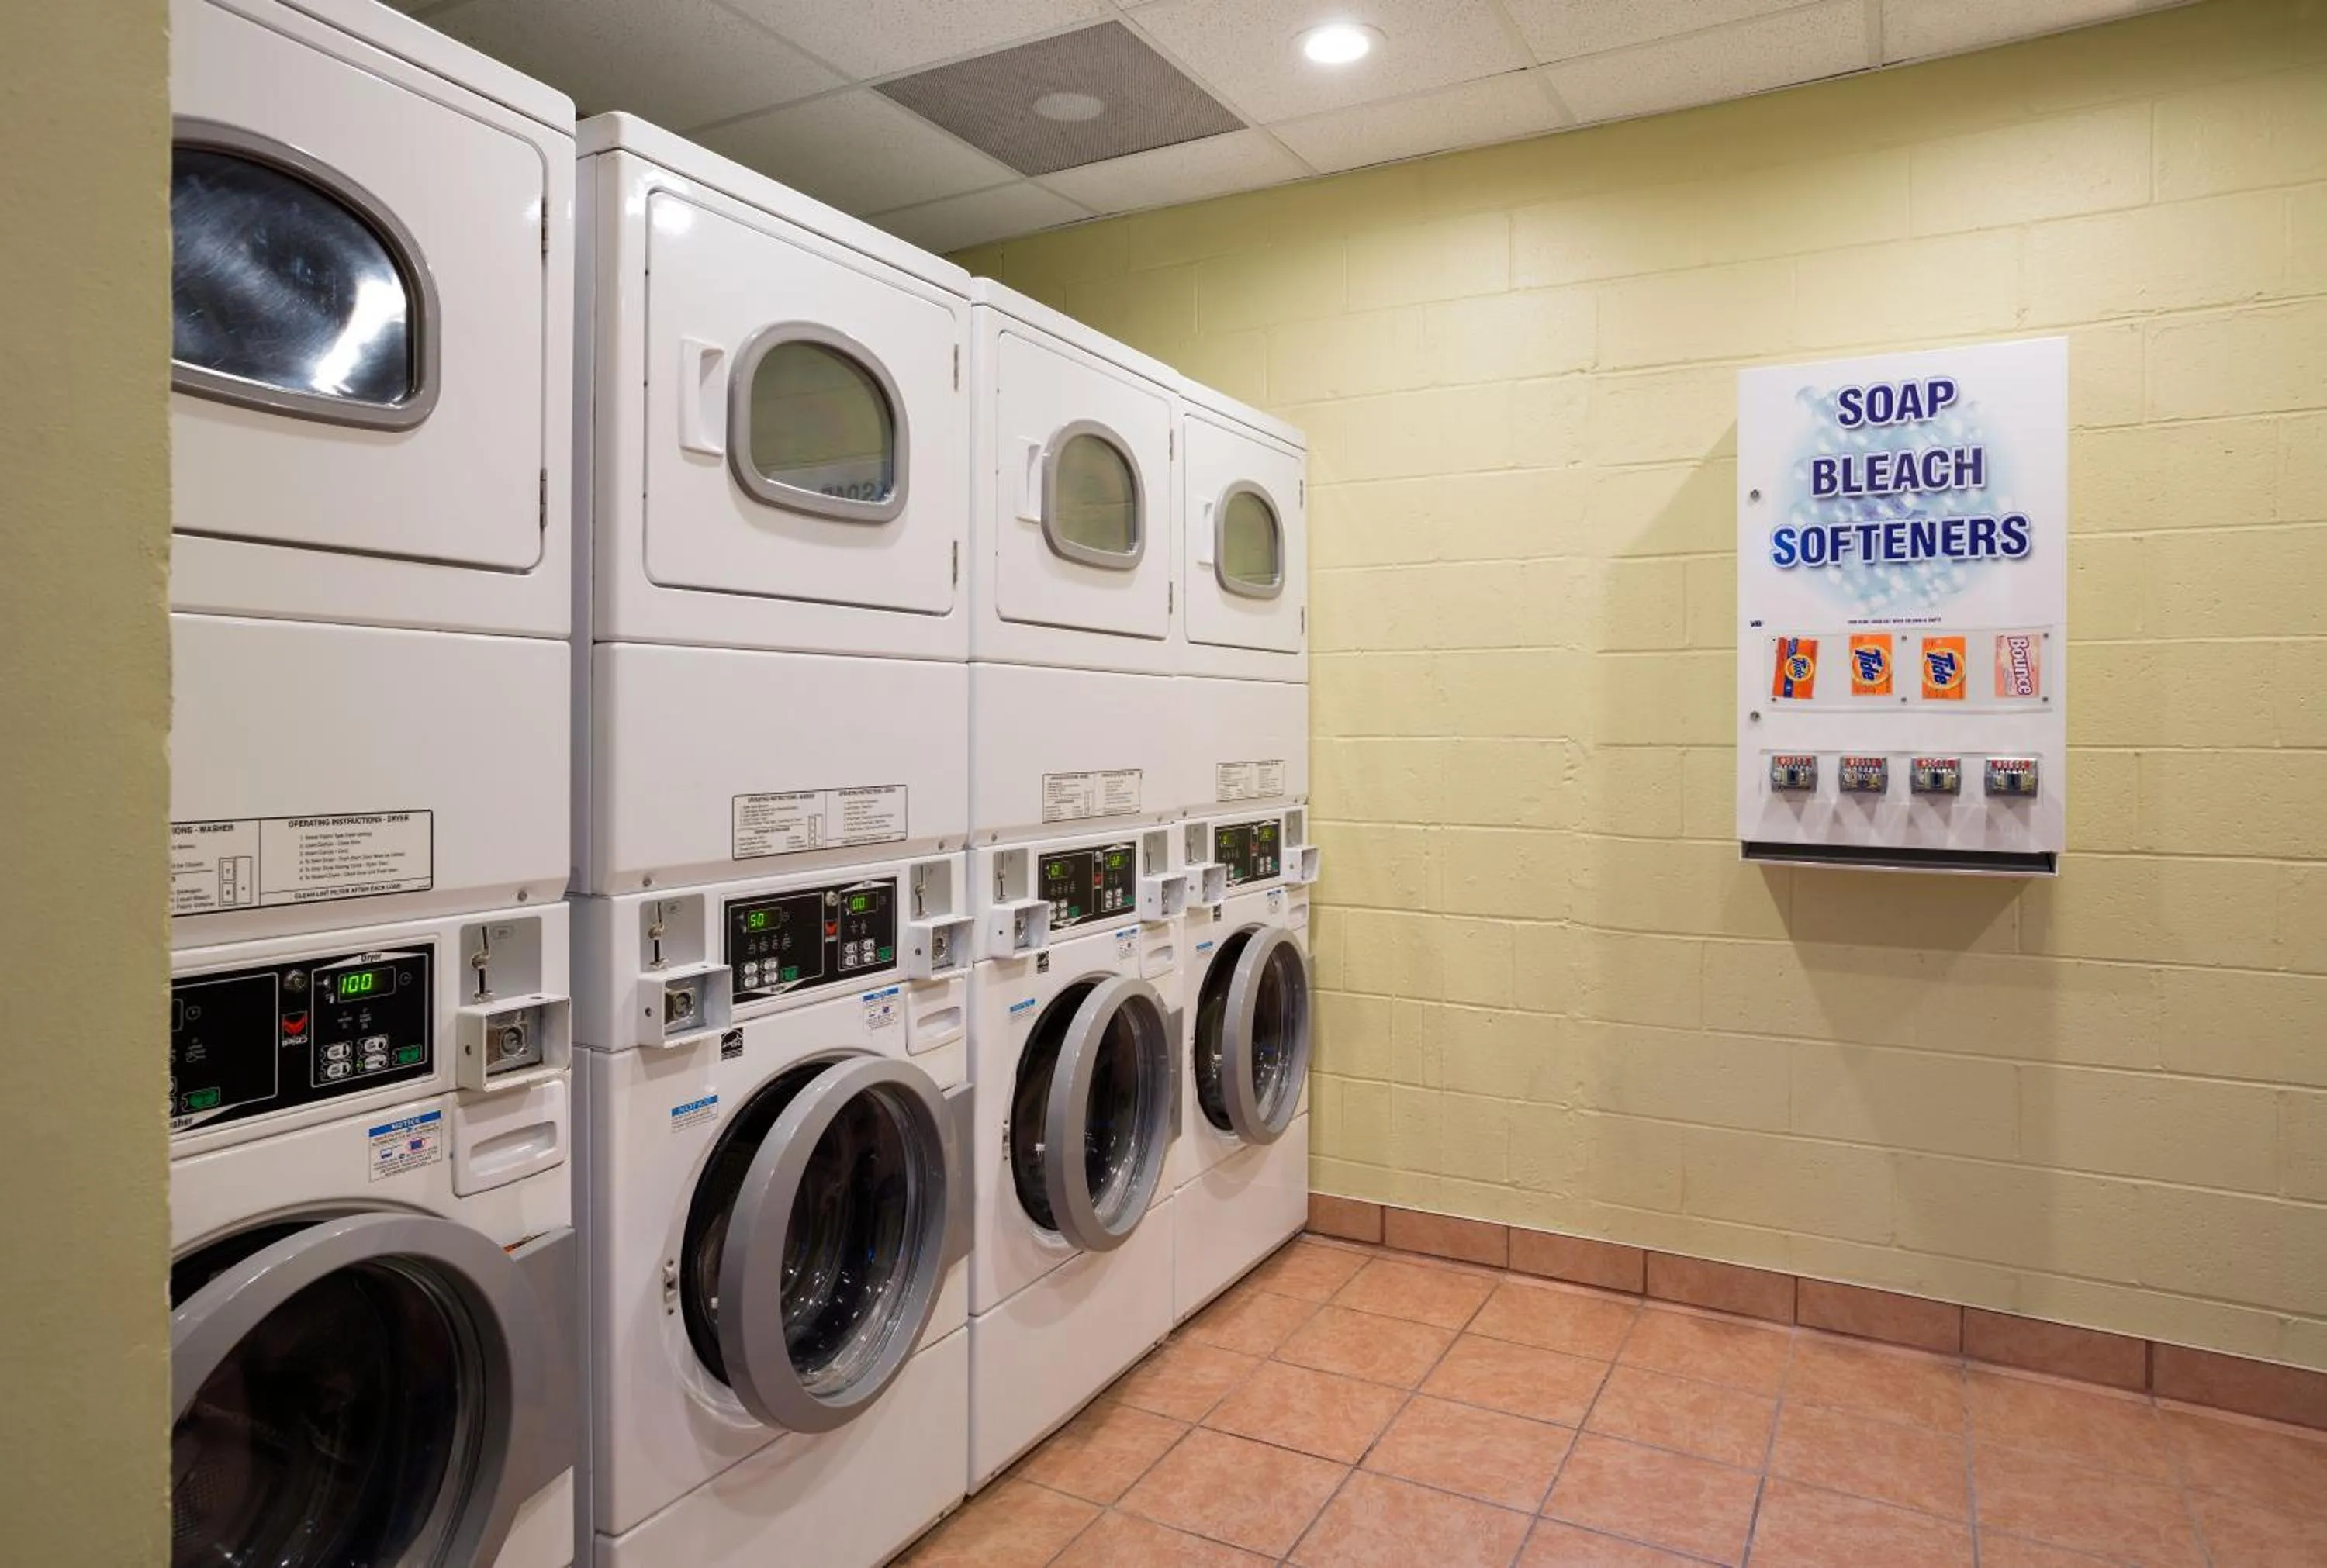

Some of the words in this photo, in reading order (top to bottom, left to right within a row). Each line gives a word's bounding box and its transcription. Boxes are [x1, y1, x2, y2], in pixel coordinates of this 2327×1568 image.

[1838, 378, 1956, 428] SOAP
[1811, 446, 1985, 497] BLEACH
[1772, 514, 2030, 567] SOFTENERS
[1855, 649, 1883, 681] Tide
[1927, 652, 1956, 685] Tide
[2007, 636, 2033, 695] Bounce
[288, 818, 330, 828] OPERATING
[749, 912, 764, 927] 50
[341, 973, 373, 993] 100
